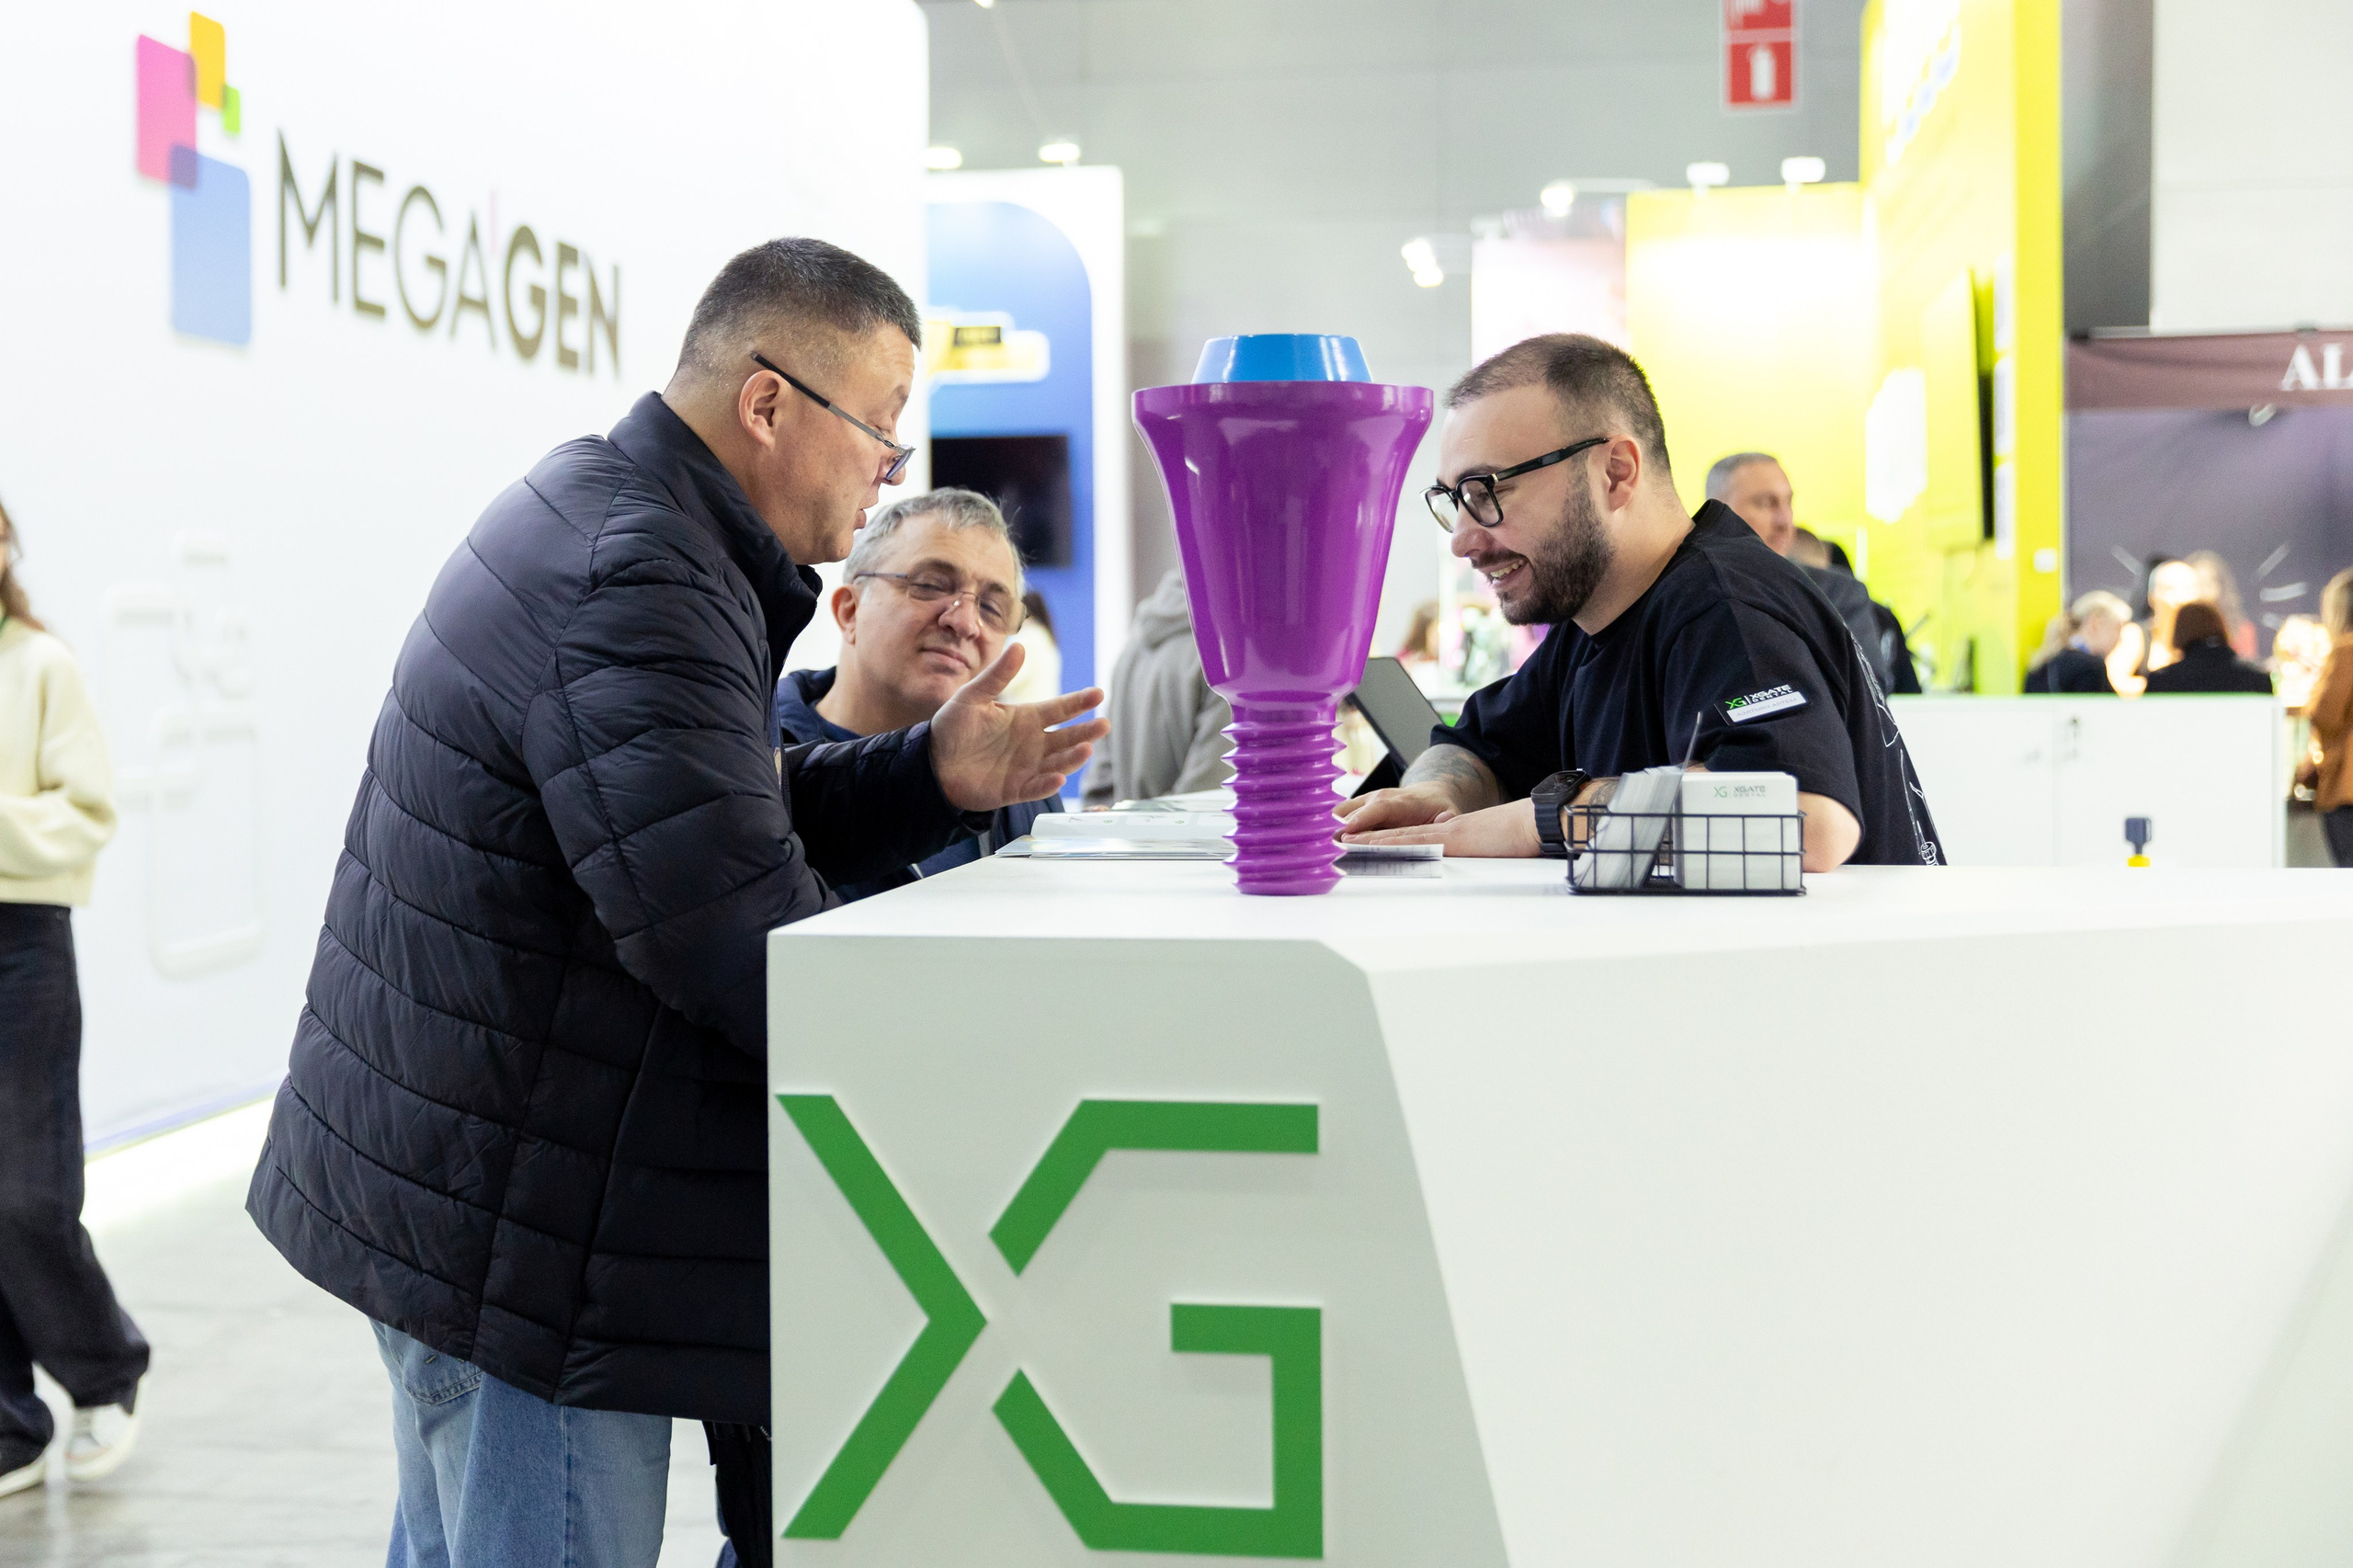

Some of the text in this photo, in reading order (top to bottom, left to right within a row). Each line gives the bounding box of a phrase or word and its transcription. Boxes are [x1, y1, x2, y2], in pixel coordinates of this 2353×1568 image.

[1724, 684, 1791, 710] XG XGATE
[1713, 785, 1766, 799] XG XGATE
[775, 1094, 1324, 1559] XG
